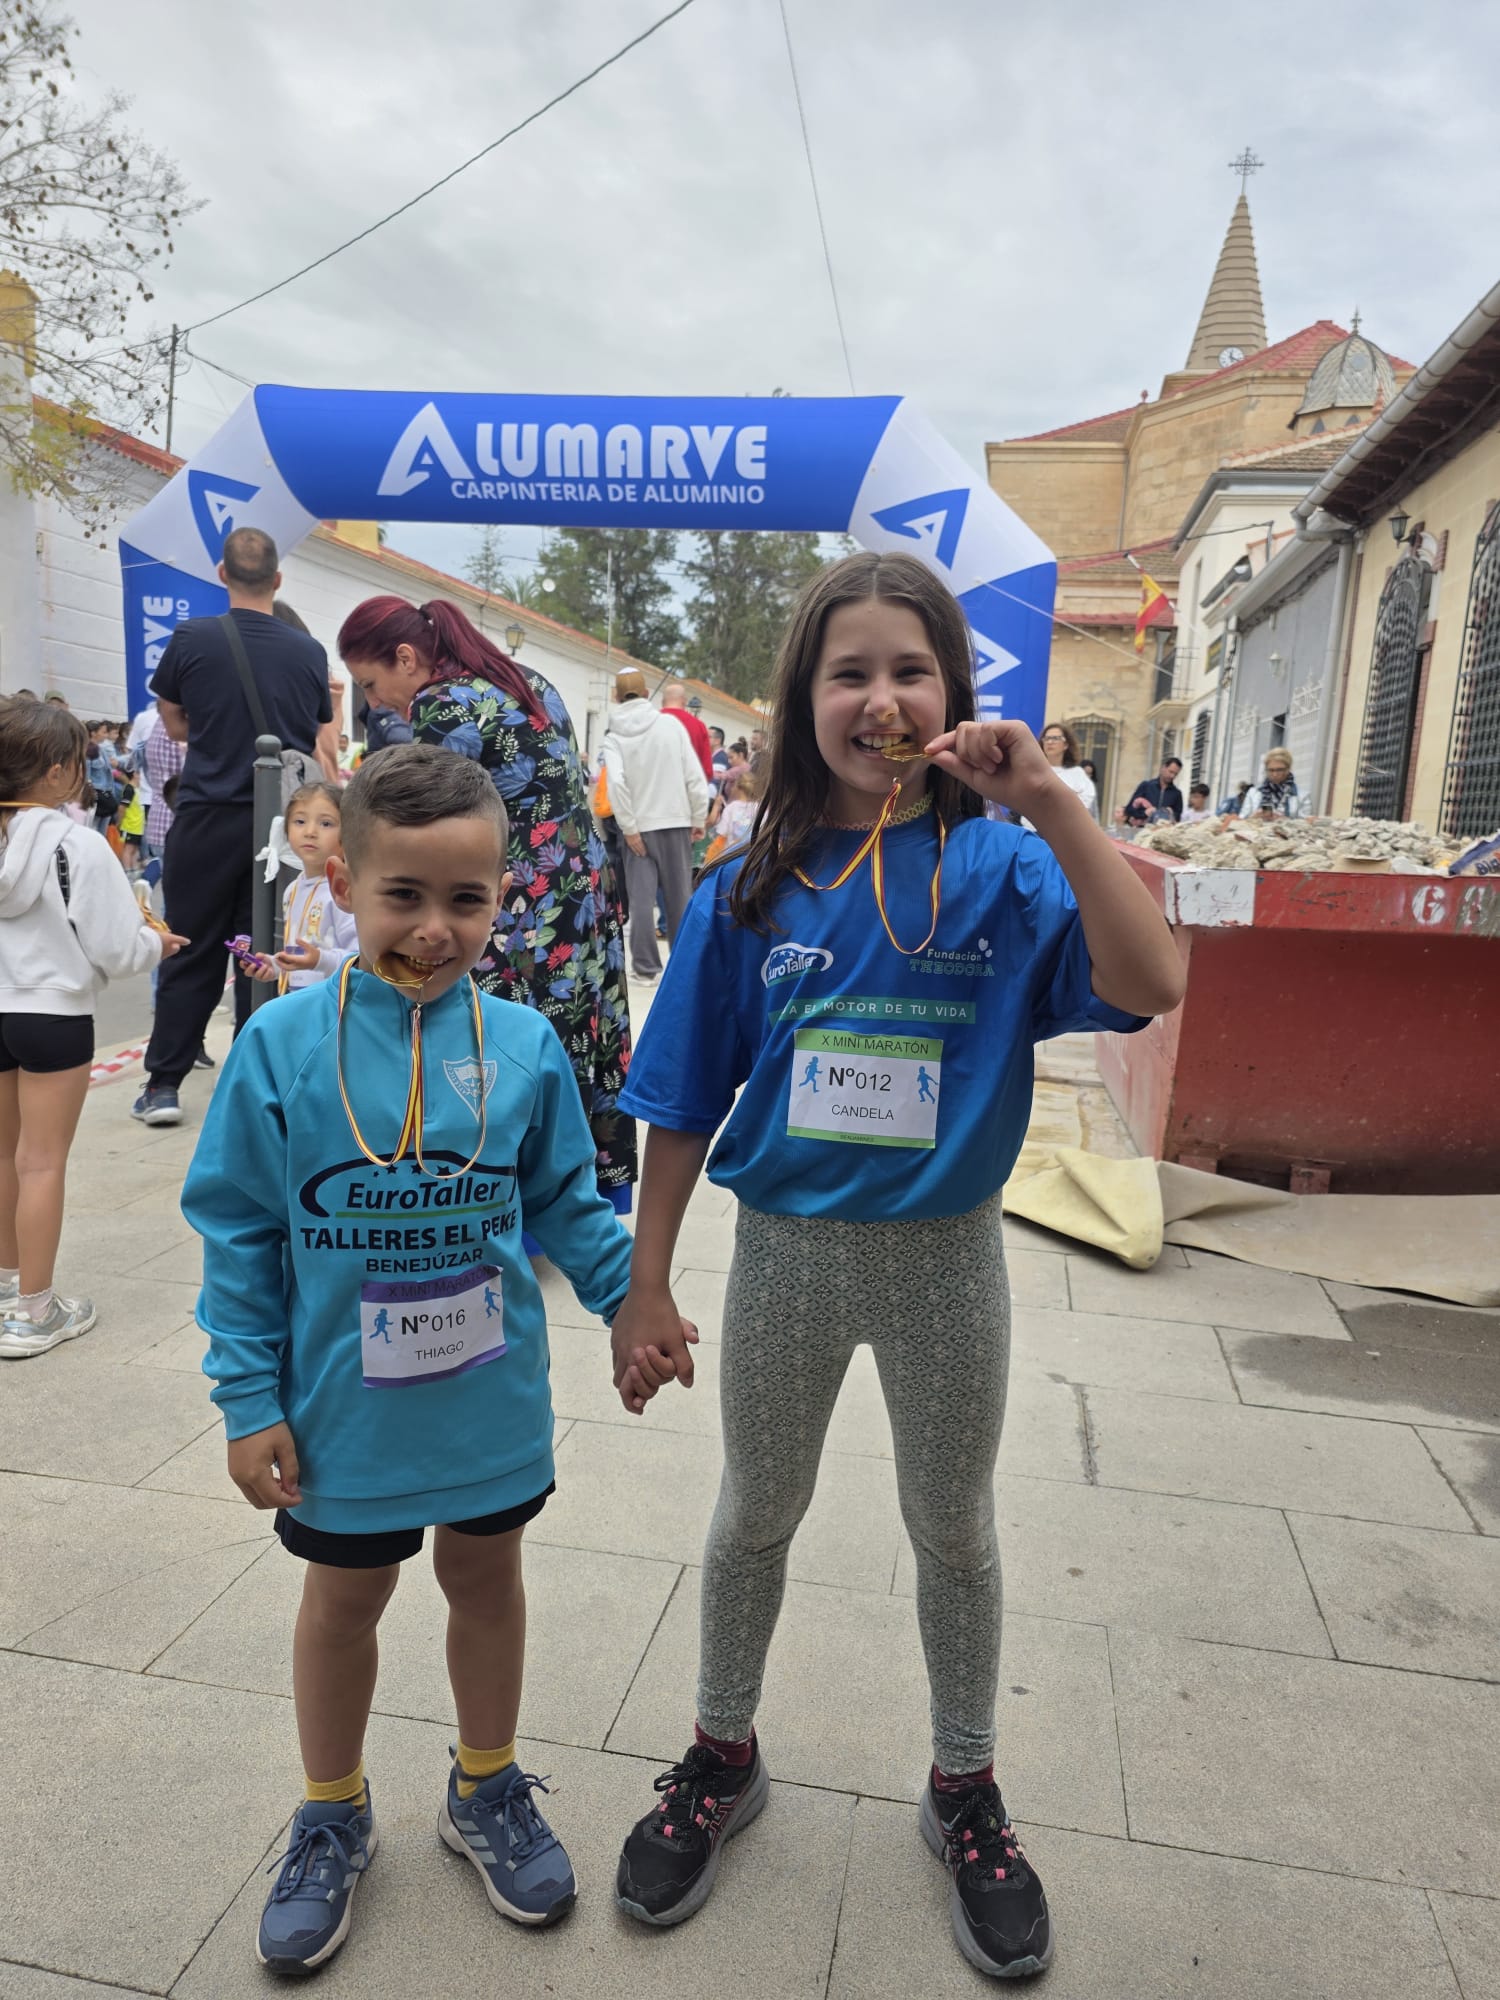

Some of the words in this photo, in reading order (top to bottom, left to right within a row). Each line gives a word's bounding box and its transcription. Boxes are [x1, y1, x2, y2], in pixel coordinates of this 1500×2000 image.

[377, 401, 767, 496] ALUMARVE
[451, 480, 602, 502] CARPINTERIA
[608, 483, 638, 503] DE
[643, 484, 765, 505] ALUMINIO
[927, 948, 982, 962] Fundación
[823, 1001, 877, 1013] MOTOR
[885, 1003, 903, 1014] DE
[910, 1005, 927, 1015] TU
[935, 1006, 967, 1018] VIDA
[821, 1034, 831, 1046] X
[833, 1035, 861, 1049] MINI
[864, 1038, 929, 1055] MARATÓN
[831, 1104, 894, 1121] CANDELA
[346, 1176, 502, 1210] EuroTaller
[300, 1226, 436, 1251] TALLERES
[444, 1223, 475, 1247] EL
[481, 1208, 517, 1241] PEKE
[365, 1247, 483, 1273] BENEJÚZAR
[388, 1287, 397, 1297] X
[401, 1285, 430, 1297] MINI
[415, 1340, 465, 1361] THIAGO
